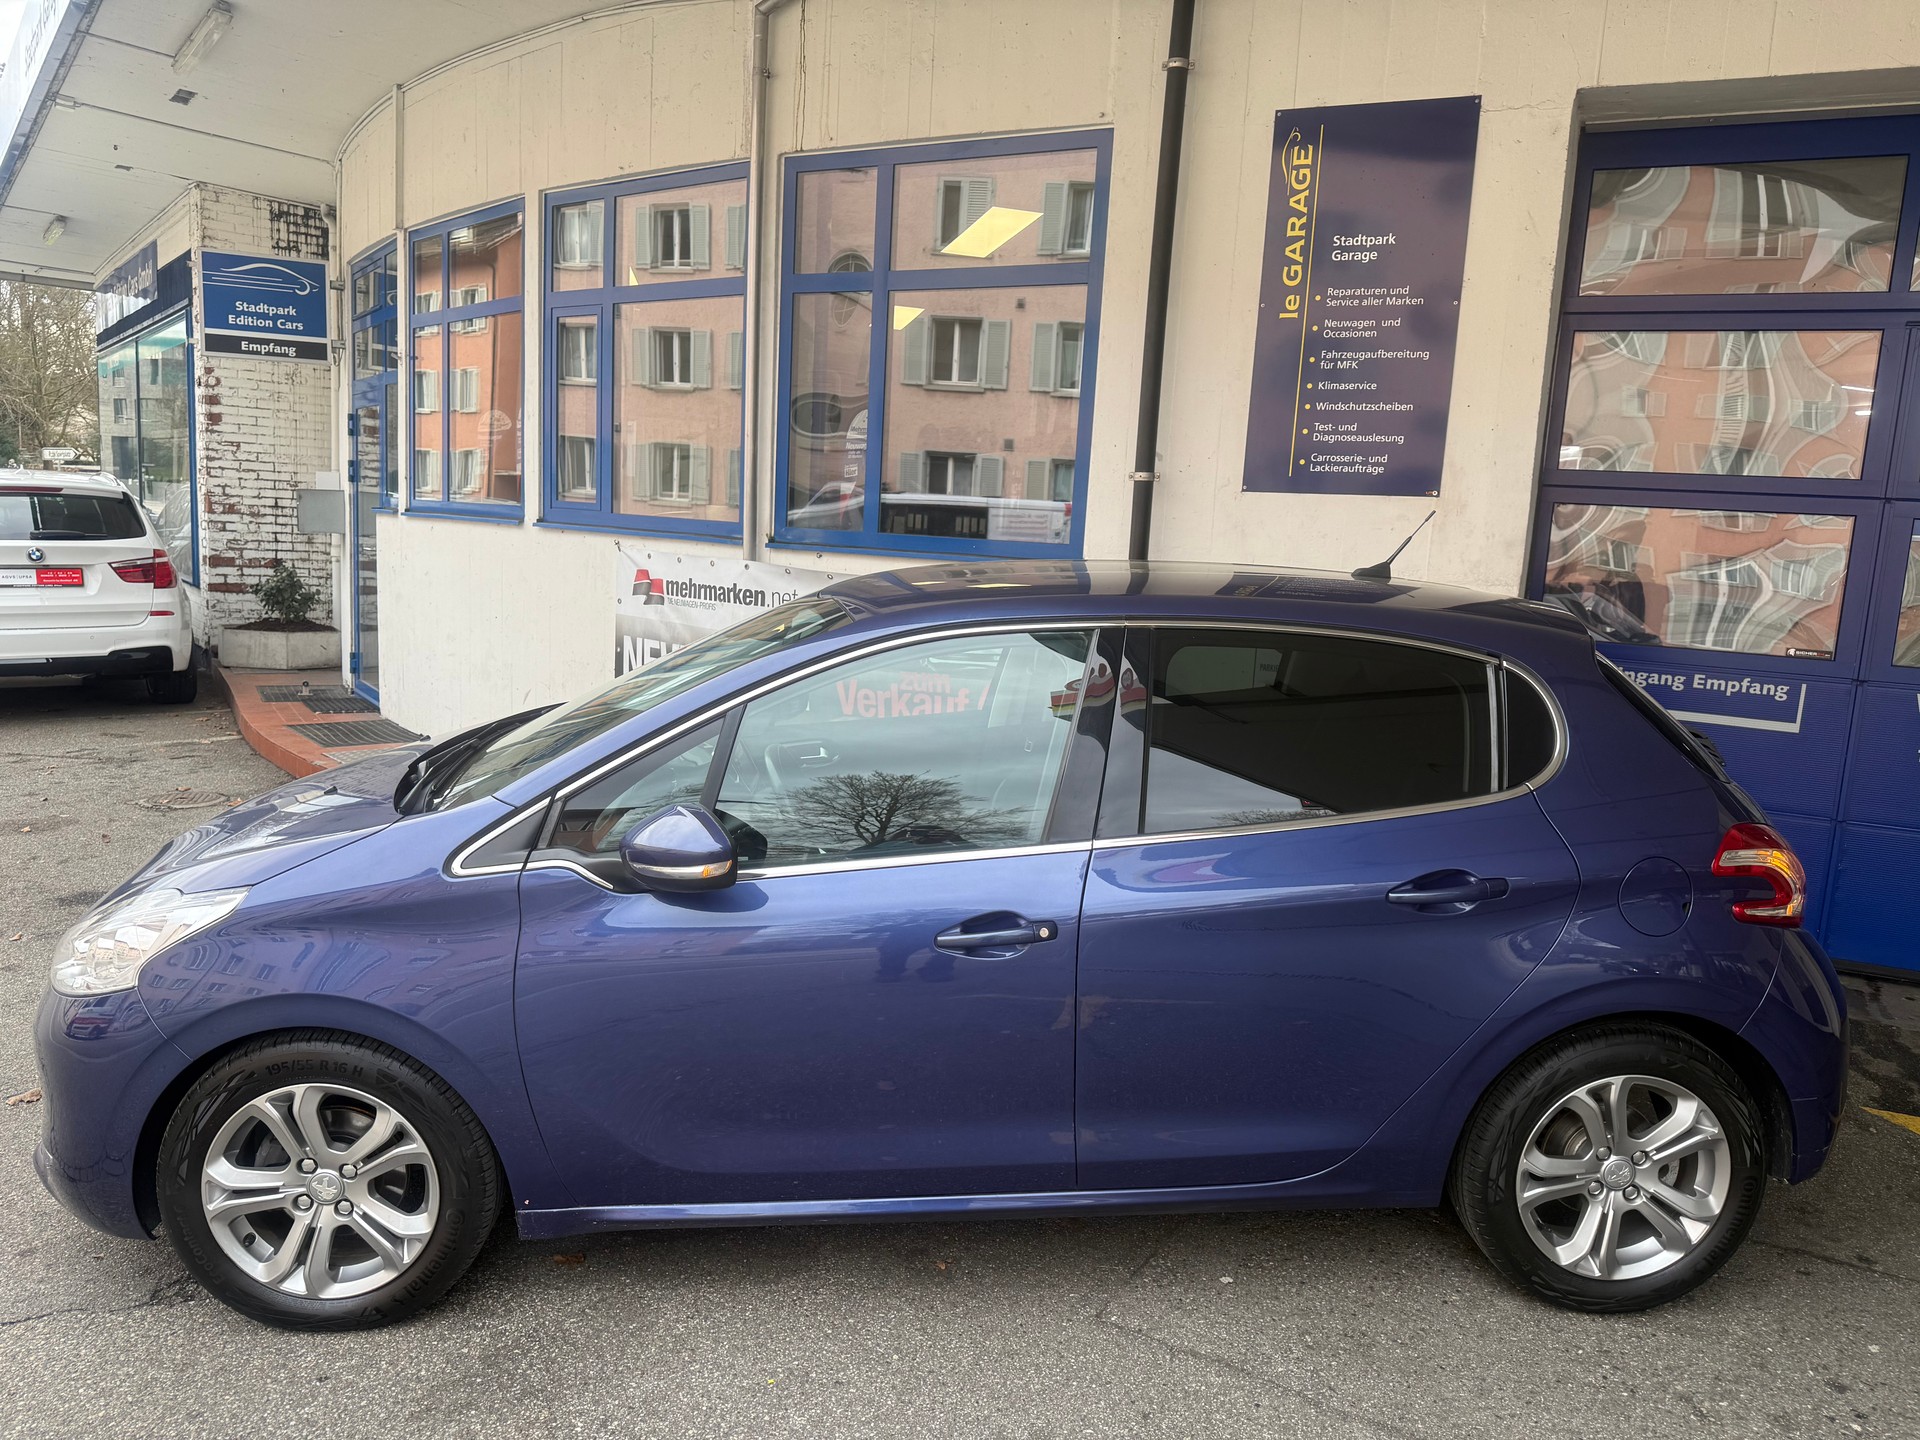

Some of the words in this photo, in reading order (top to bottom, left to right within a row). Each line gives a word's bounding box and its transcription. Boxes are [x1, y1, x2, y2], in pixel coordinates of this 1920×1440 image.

[1282, 144, 1313, 286] GARAGE
[1333, 233, 1396, 248] Stadtpark
[1332, 250, 1378, 263] Garage
[1327, 287, 1387, 298] Reparaturen
[1390, 285, 1410, 295] und
[1279, 295, 1300, 319] le
[1326, 297, 1360, 307] Service
[1361, 297, 1384, 306] aller
[1386, 296, 1424, 305] Marken
[235, 301, 297, 316] Stadtpark
[228, 314, 273, 328] Edition
[277, 319, 304, 331] Cars
[1324, 319, 1376, 329] Neuwagen
[1381, 317, 1401, 327] und
[1323, 329, 1377, 339] Occasionen
[241, 341, 297, 357] Empfang
[1321, 349, 1430, 361] Fahrzeugaufbereitung
[1320, 360, 1335, 369] für
[1337, 360, 1359, 369] MFK
[1318, 381, 1377, 390] Klimaservice
[1316, 401, 1414, 411] Windschutzscheiben
[1314, 422, 1336, 431] Test-
[1338, 422, 1358, 431] und
[1313, 433, 1405, 444] Diagnoseauslesung
[1311, 453, 1366, 463] Carrosserie-
[1368, 454, 1388, 463] und
[1310, 463, 1385, 475] Lackieraufträge
[665, 578, 799, 608] mehrmarken.net
[900, 671, 950, 693] zum
[1693, 674, 1790, 701] Empfang
[265, 1059, 314, 1076] 195/55
[320, 1060, 329, 1071] R
[333, 1061, 348, 1074] 16
[352, 1064, 364, 1078] H
[403, 1207, 466, 1299] Continental
